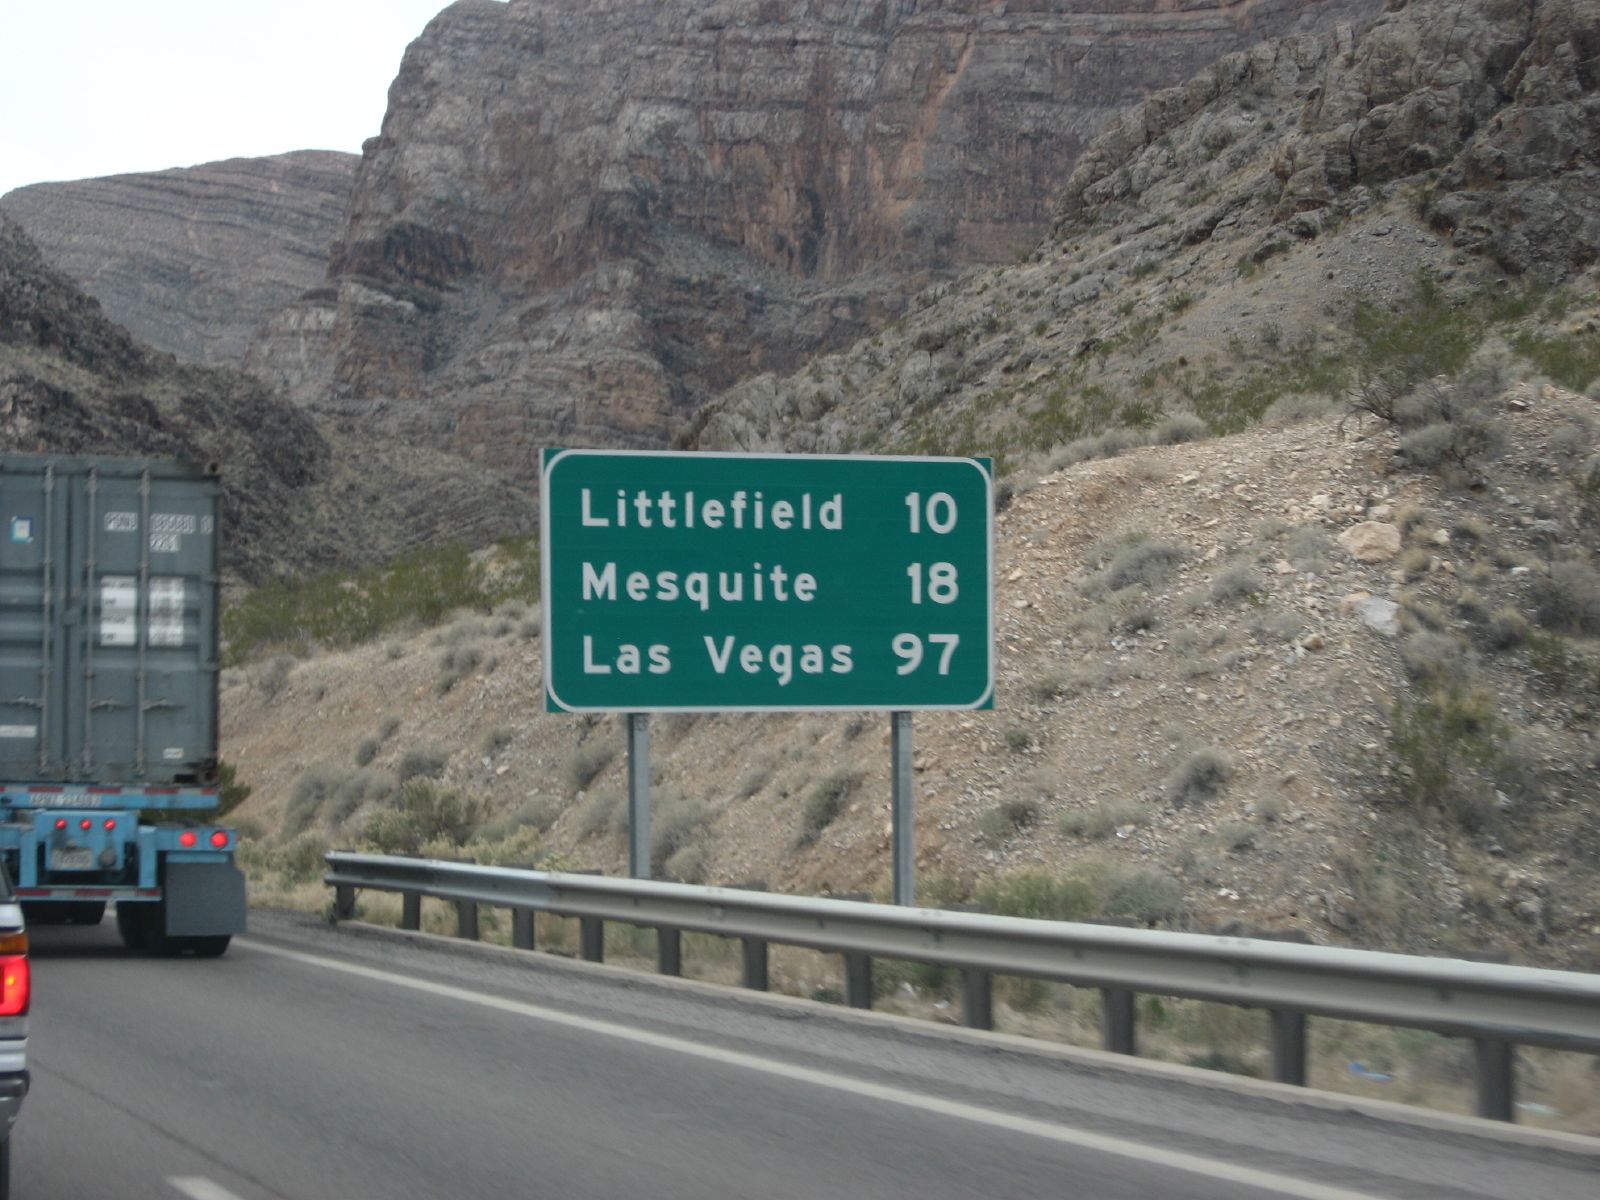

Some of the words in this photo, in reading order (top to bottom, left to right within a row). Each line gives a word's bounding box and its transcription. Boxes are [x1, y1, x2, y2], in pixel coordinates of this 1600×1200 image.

[582, 489, 842, 529] Littlefield
[906, 492, 957, 533] 10
[583, 562, 816, 610] Mesquite
[908, 562, 958, 604] 18
[584, 636, 670, 673] Las
[704, 636, 852, 685] Vegas
[892, 633, 959, 675] 97
